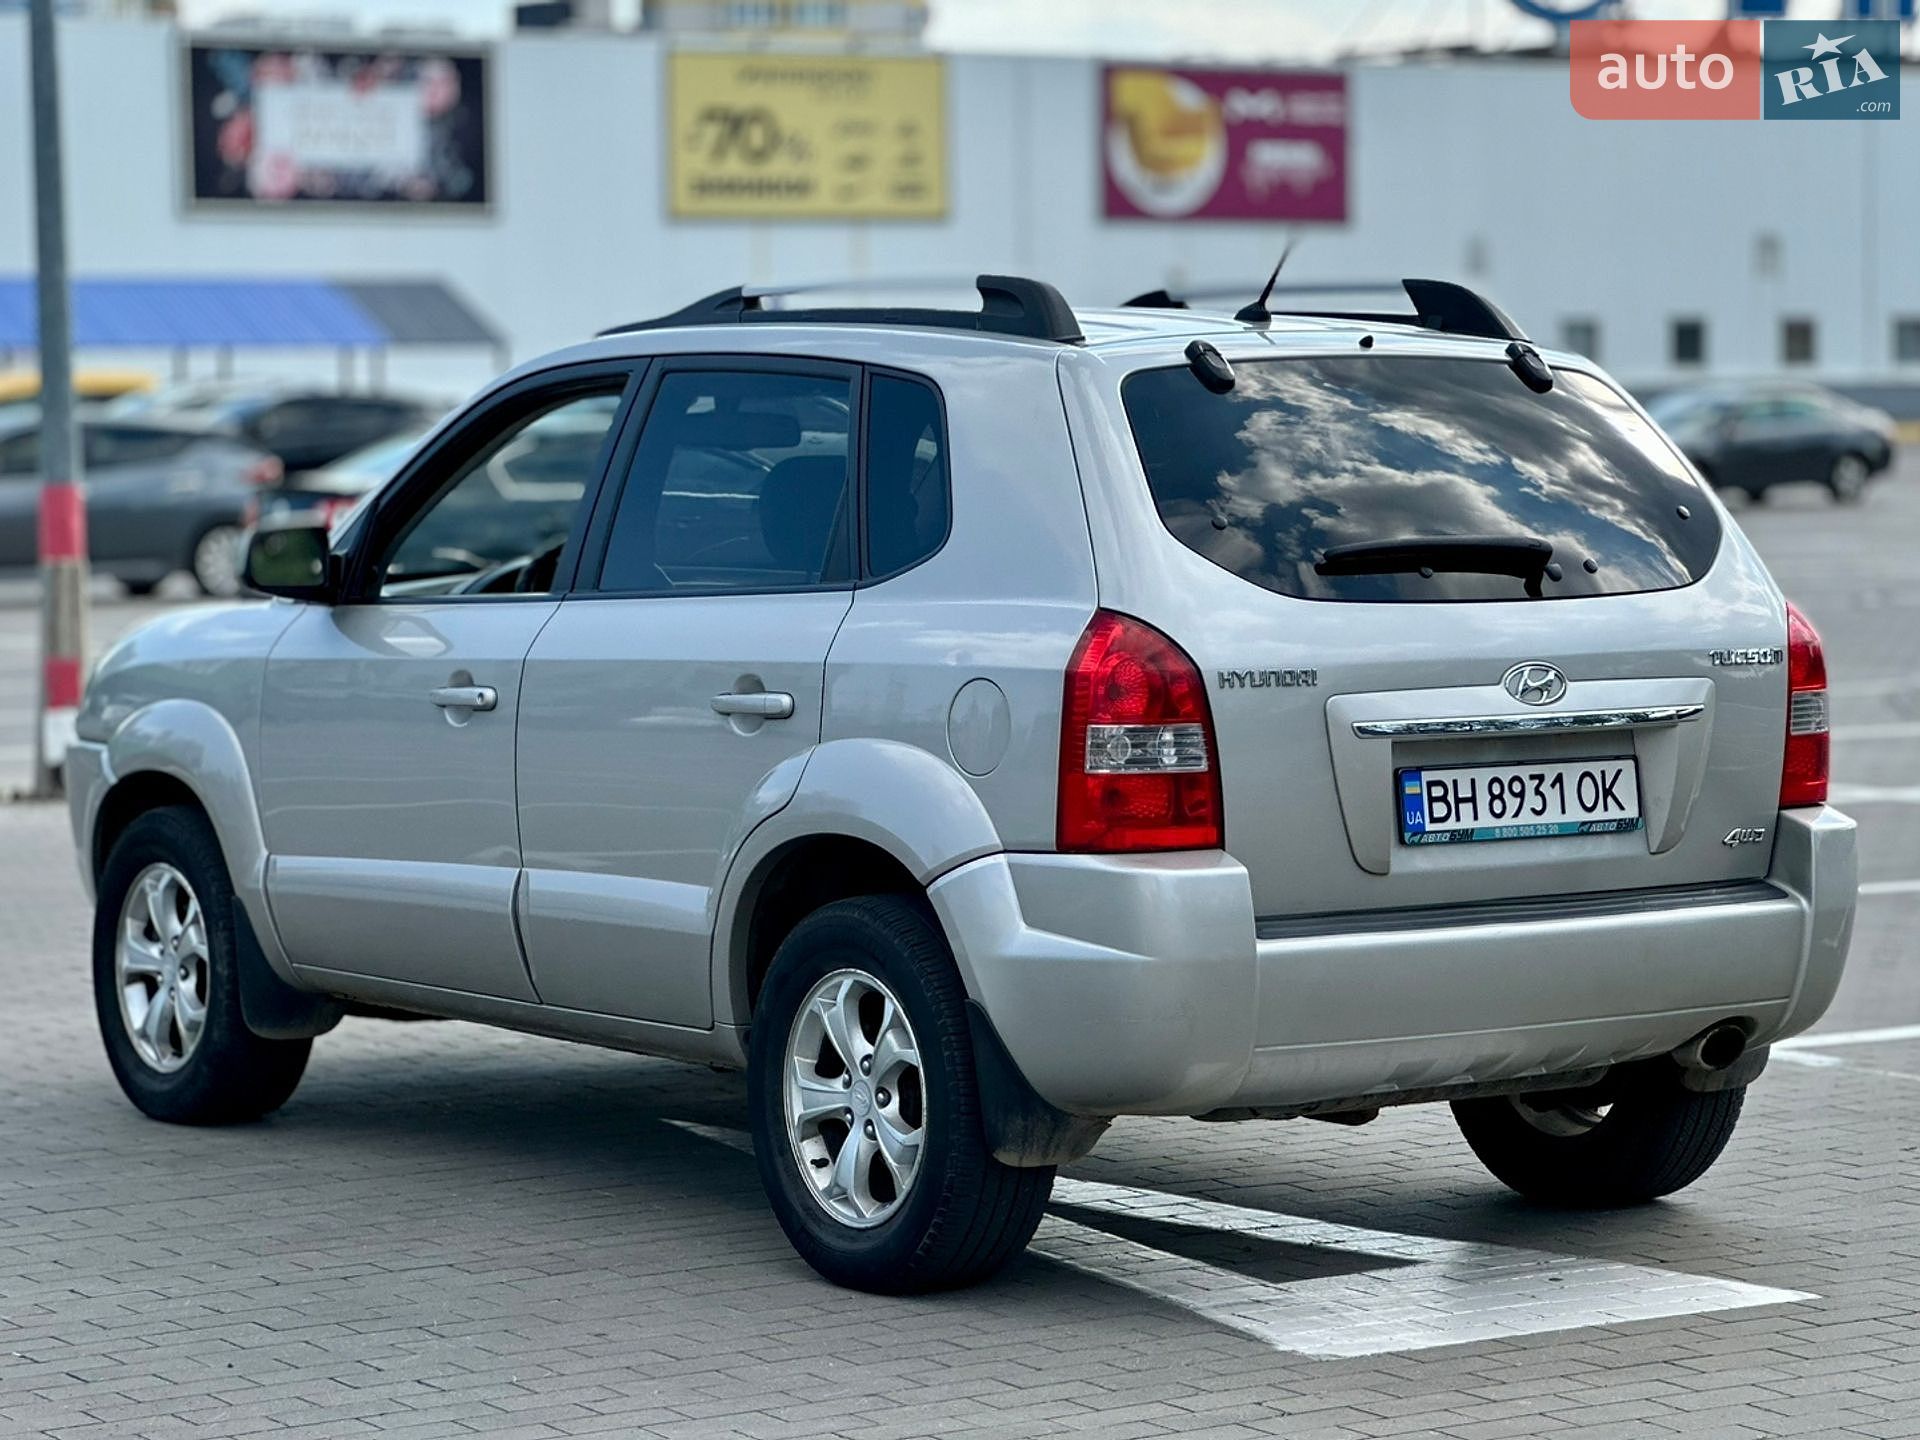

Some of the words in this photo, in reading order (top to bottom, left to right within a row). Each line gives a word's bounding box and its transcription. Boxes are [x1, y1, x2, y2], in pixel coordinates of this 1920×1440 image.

[1709, 647, 1783, 667] TUCSON
[1217, 668, 1318, 689] HYUNDAI
[1426, 777, 1479, 824] BH
[1487, 771, 1567, 819] 8931
[1576, 768, 1626, 813] OK
[1406, 811, 1423, 825] UA
